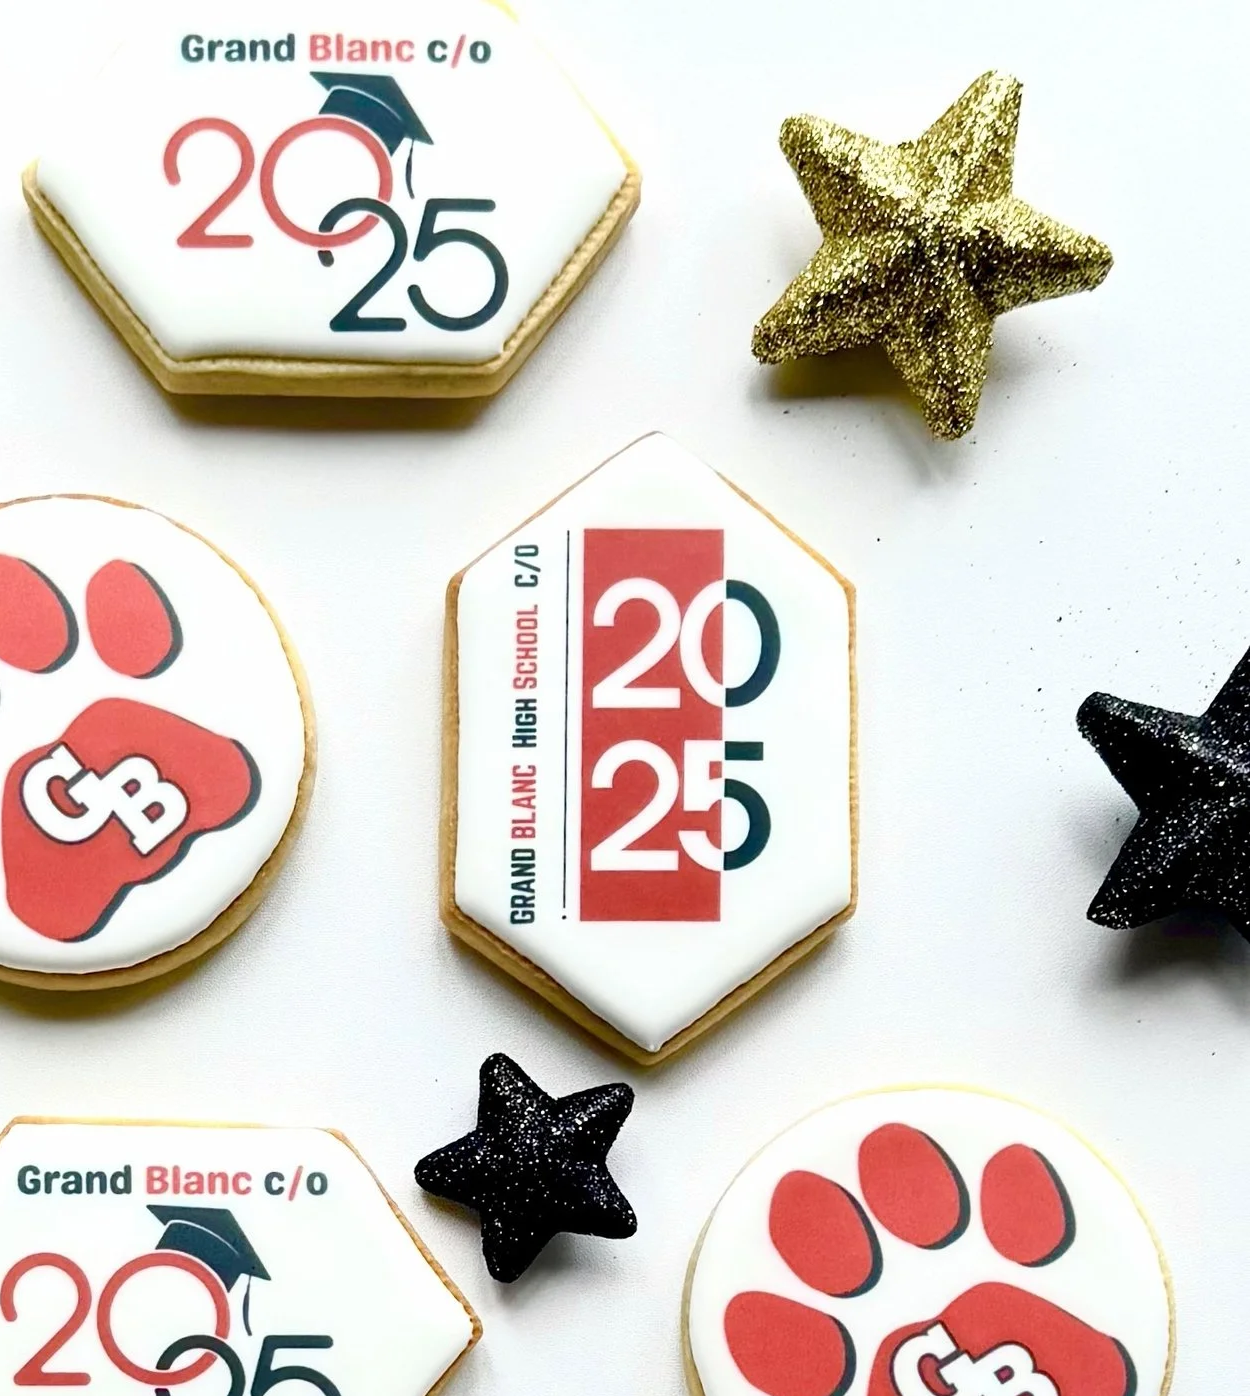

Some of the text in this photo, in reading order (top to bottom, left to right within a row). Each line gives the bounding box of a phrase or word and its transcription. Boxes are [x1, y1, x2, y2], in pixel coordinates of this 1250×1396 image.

[180, 32, 492, 68] Grand Blanc c/o
[509, 544, 542, 926] GRAND BLANC HIGH SCHOOL C/O
[21, 742, 191, 856] GB
[16, 1164, 329, 1202] Grand Blanc c/o
